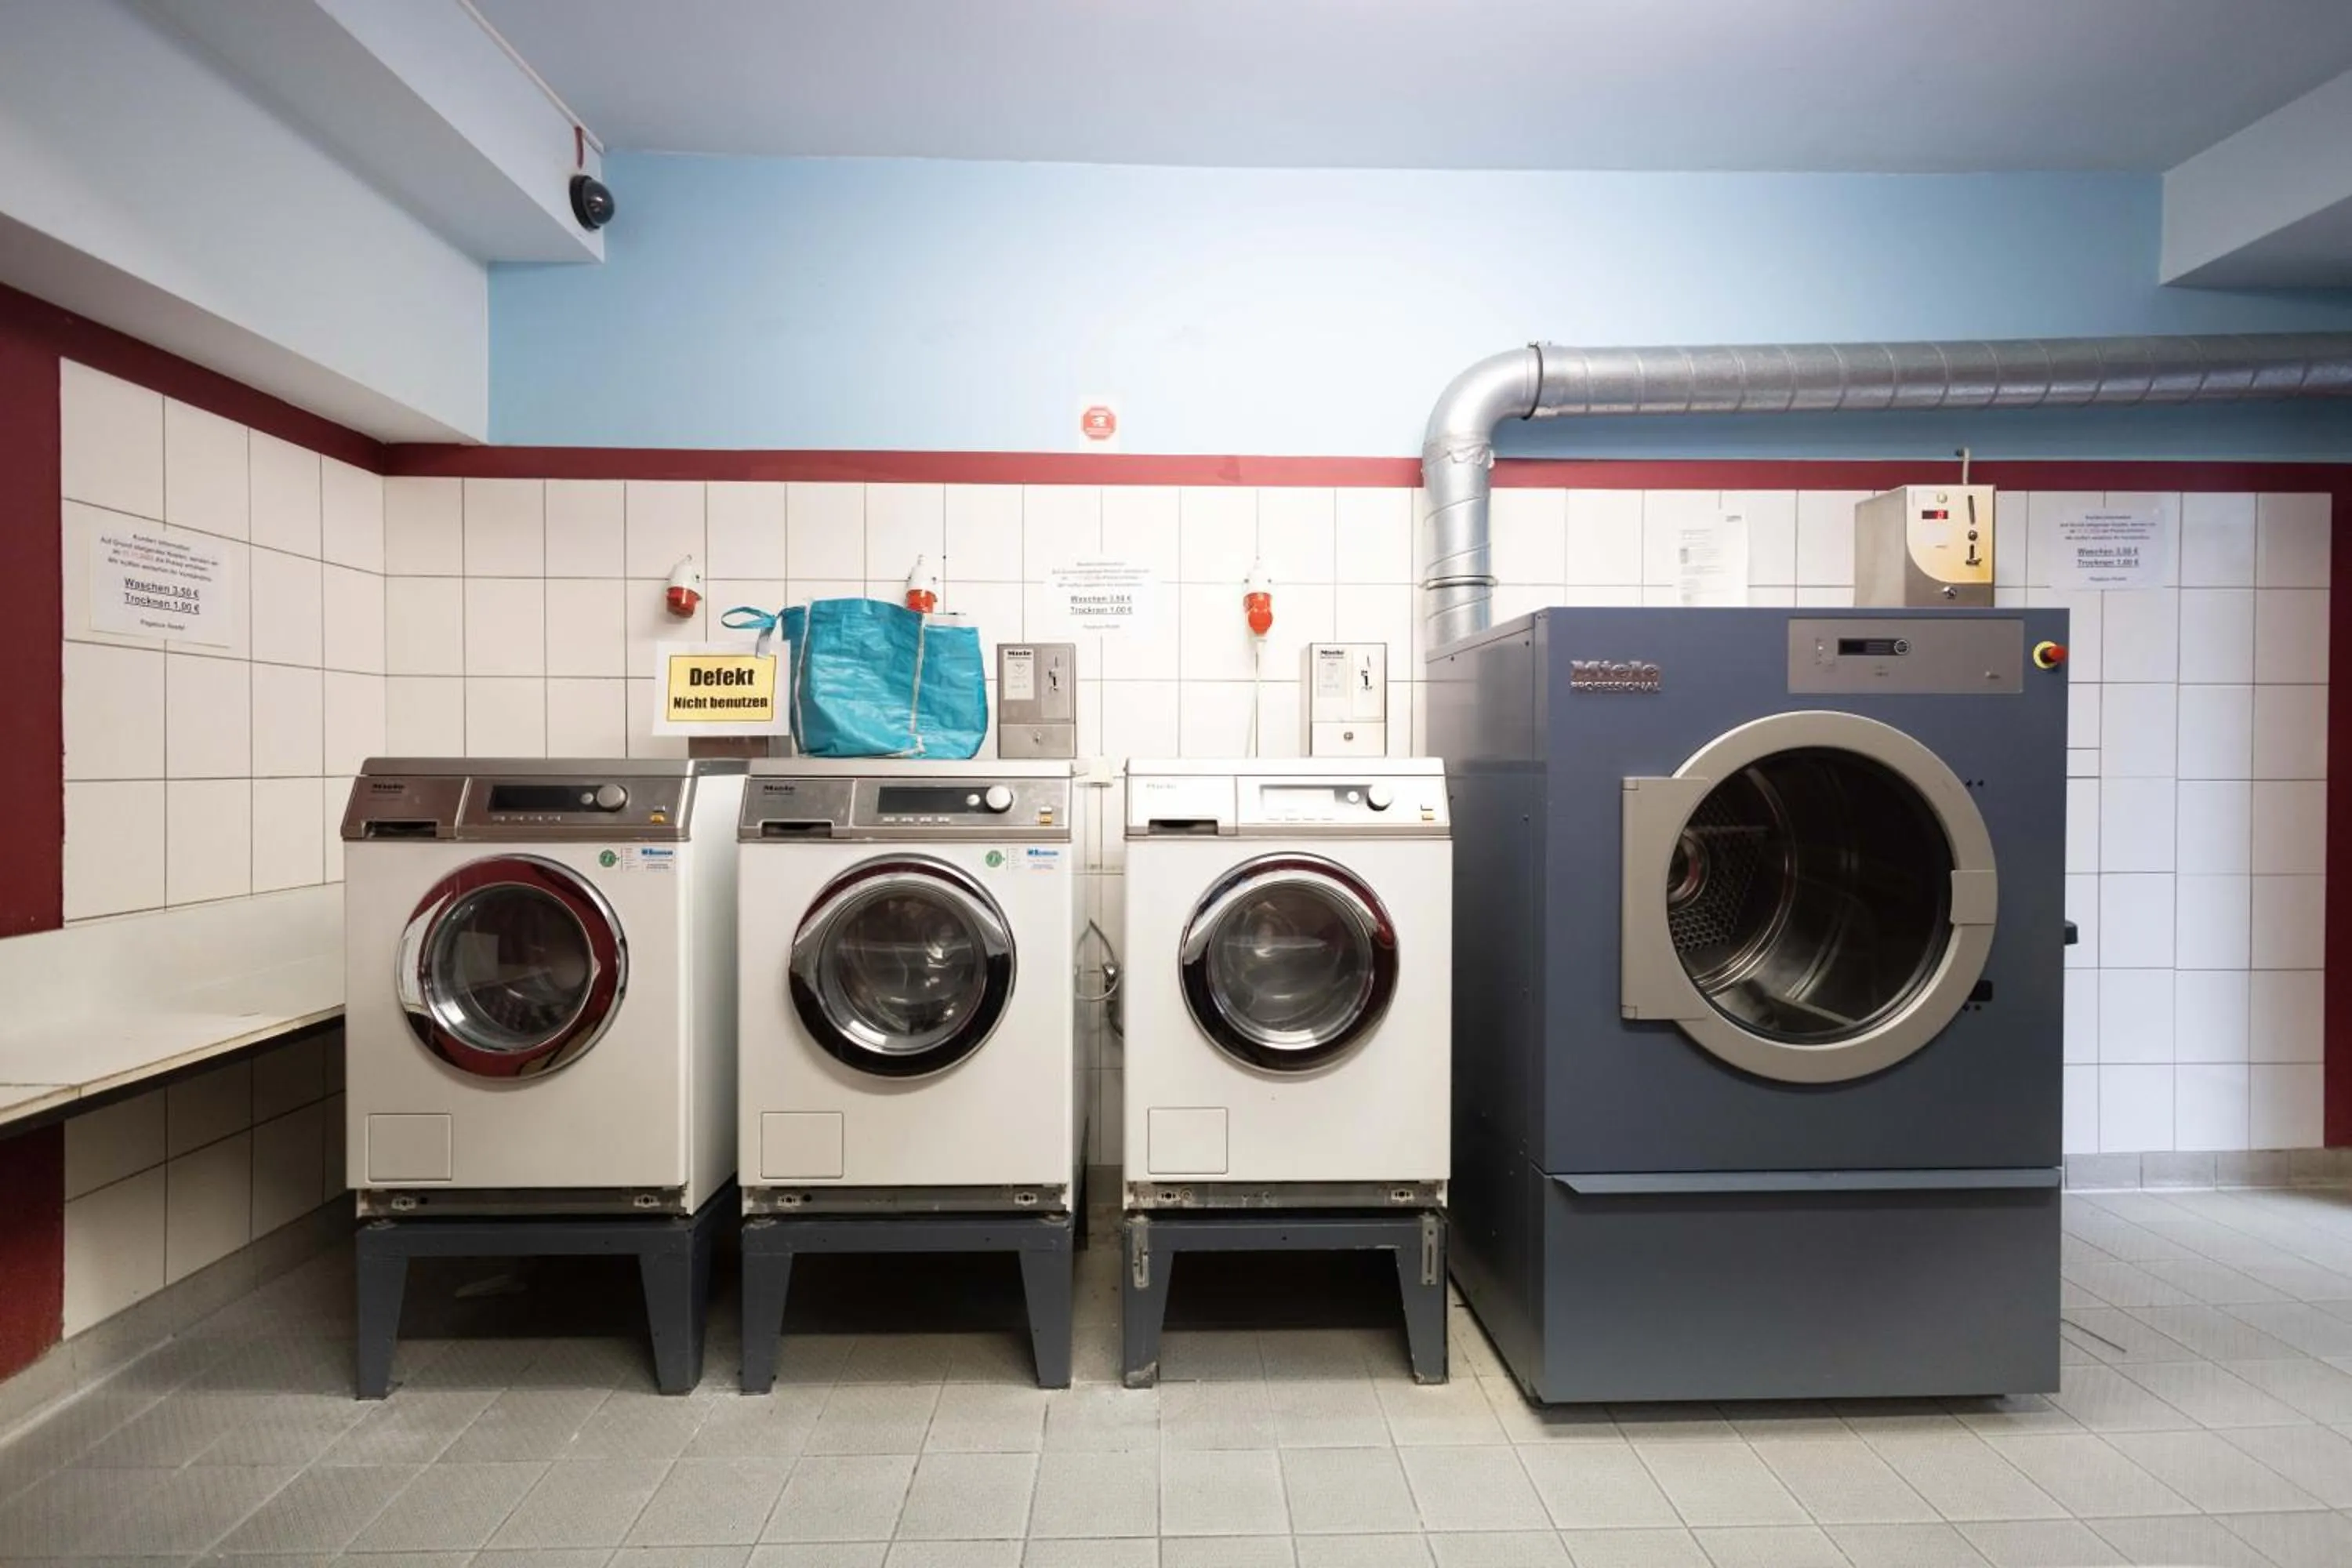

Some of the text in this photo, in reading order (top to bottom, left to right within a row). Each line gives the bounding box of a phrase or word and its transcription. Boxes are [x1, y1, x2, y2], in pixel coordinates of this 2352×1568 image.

[125, 578, 170, 594] Waschen
[172, 585, 192, 598] 3,50
[125, 592, 170, 610] Trocknen
[173, 601, 192, 613] 1,00
[689, 667, 755, 686] Defekt
[1570, 659, 1661, 682] Miele
[673, 695, 768, 710] Nicht benutzen
